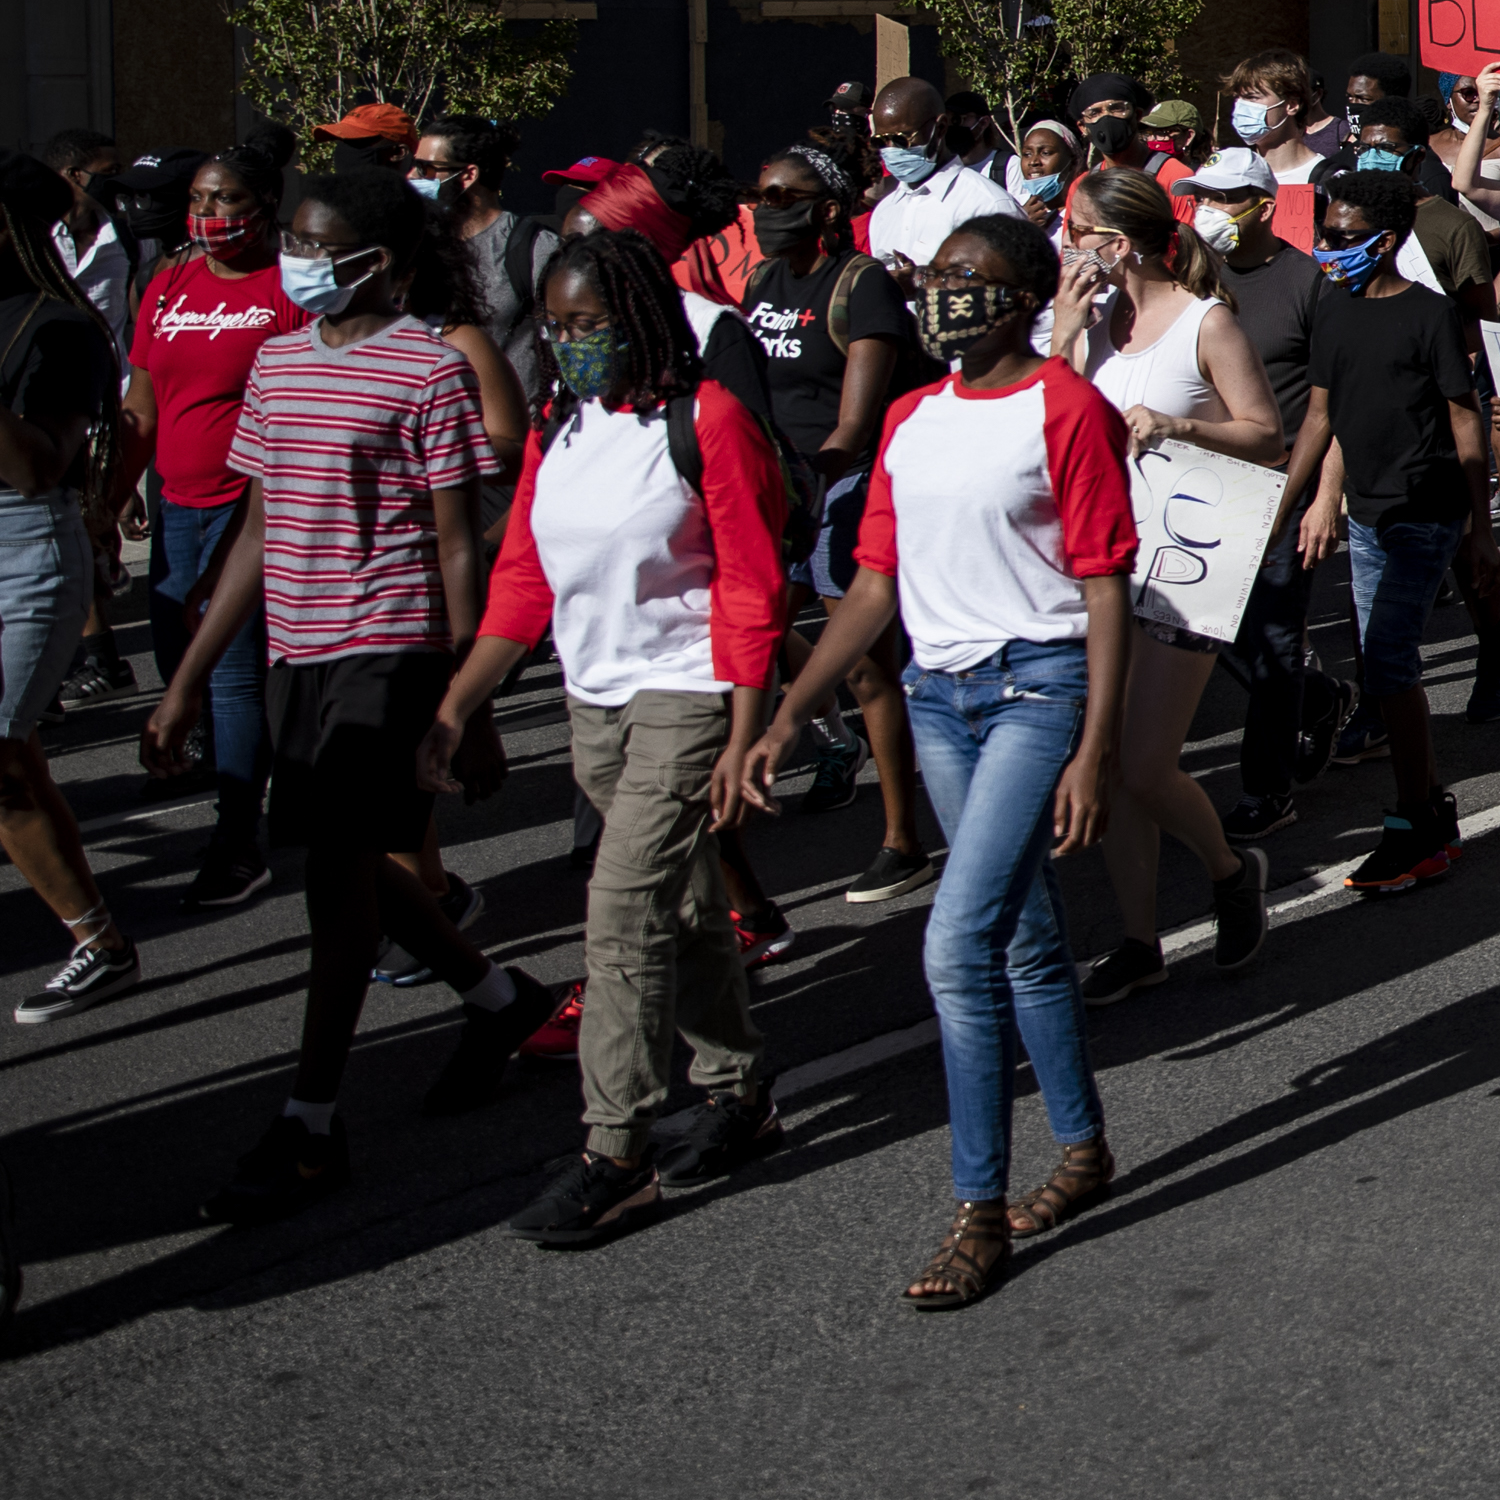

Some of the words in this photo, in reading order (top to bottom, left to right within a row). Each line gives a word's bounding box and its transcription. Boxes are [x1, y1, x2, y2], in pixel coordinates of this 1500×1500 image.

[1227, 458, 1257, 473] SHE'S
[1264, 470, 1287, 482] GOTTA
[1261, 495, 1279, 529] WHEN
[1249, 537, 1266, 570] YOU'RE
[1235, 577, 1253, 609] LIVING
[1153, 610, 1189, 628] KNEES
[1201, 624, 1226, 638] YOUR
[1230, 614, 1240, 629] ON
